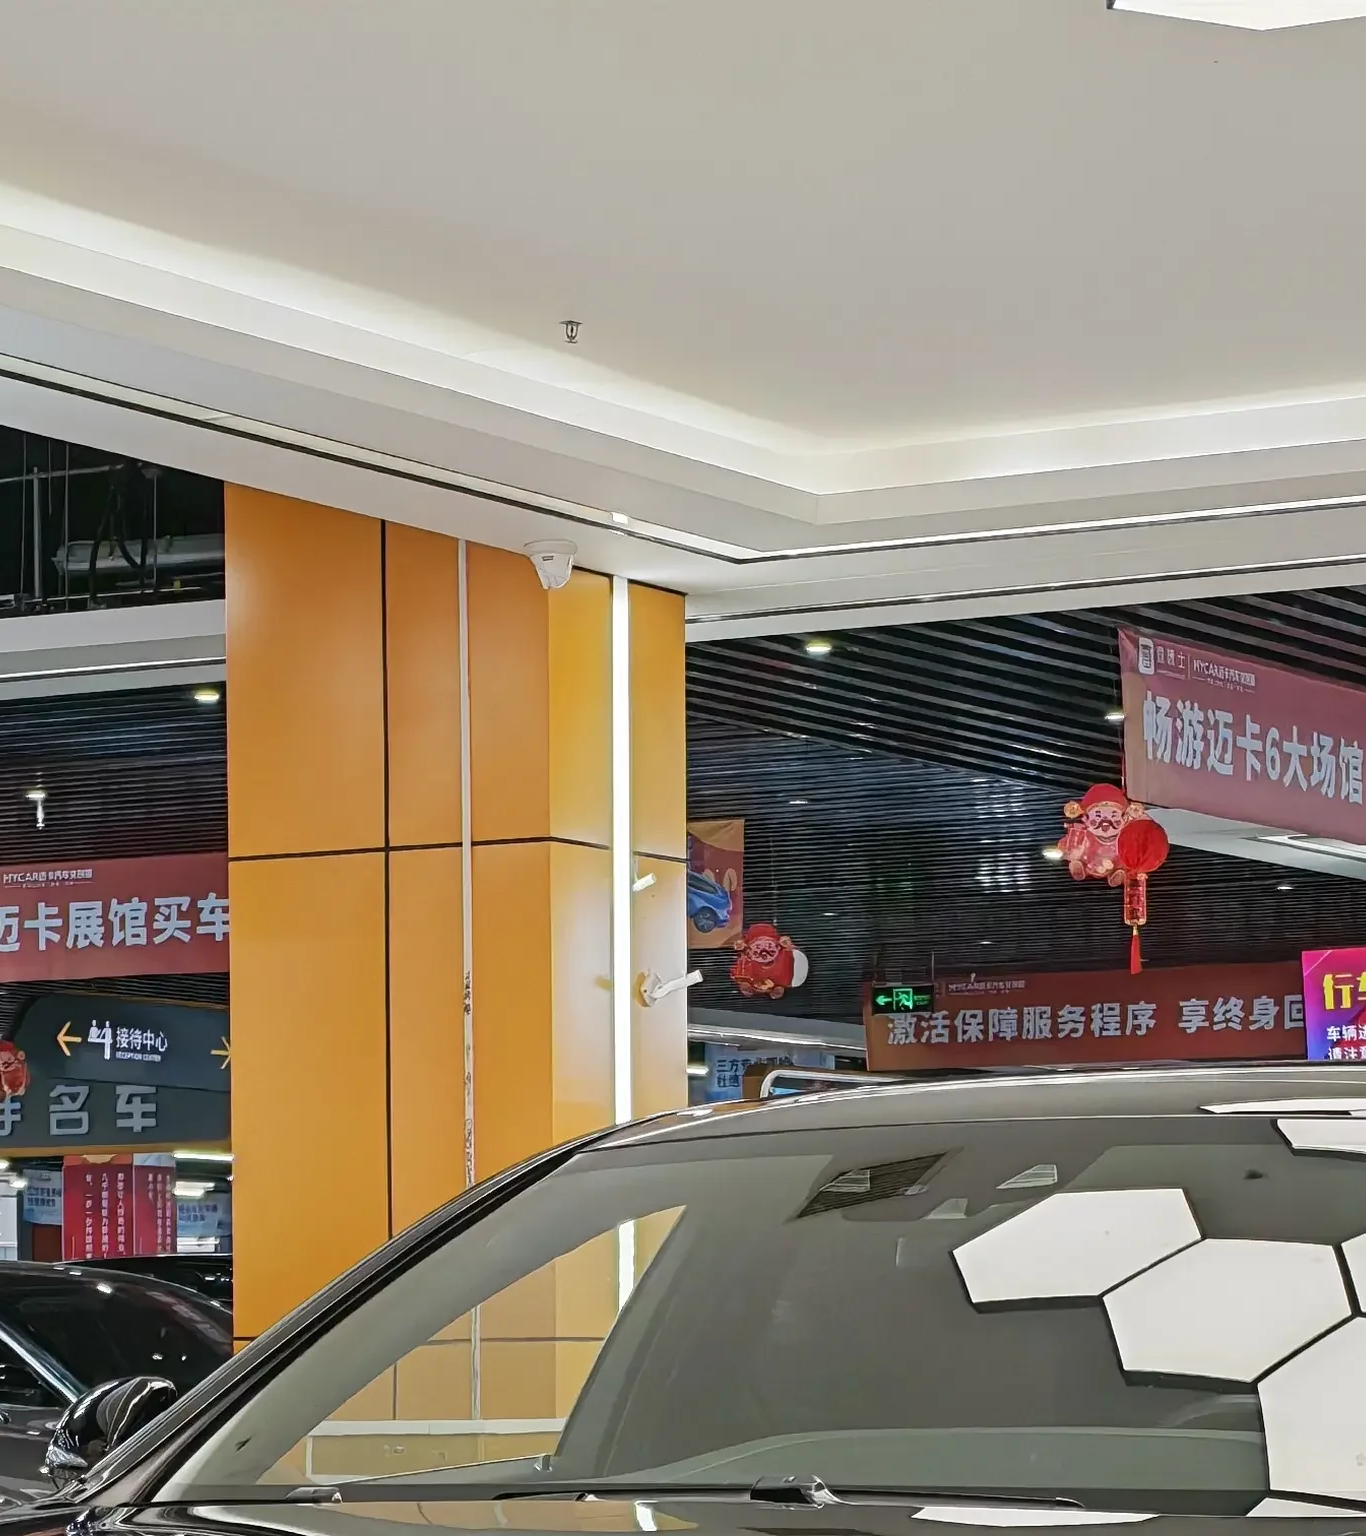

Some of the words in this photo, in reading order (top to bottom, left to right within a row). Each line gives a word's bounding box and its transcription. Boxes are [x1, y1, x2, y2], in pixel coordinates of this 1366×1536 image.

[1143, 690, 1364, 805] 畅游迈卡6大场馆
[116, 1027, 168, 1051] 接待中心
[888, 1003, 1157, 1045] 激活保障服务程序
